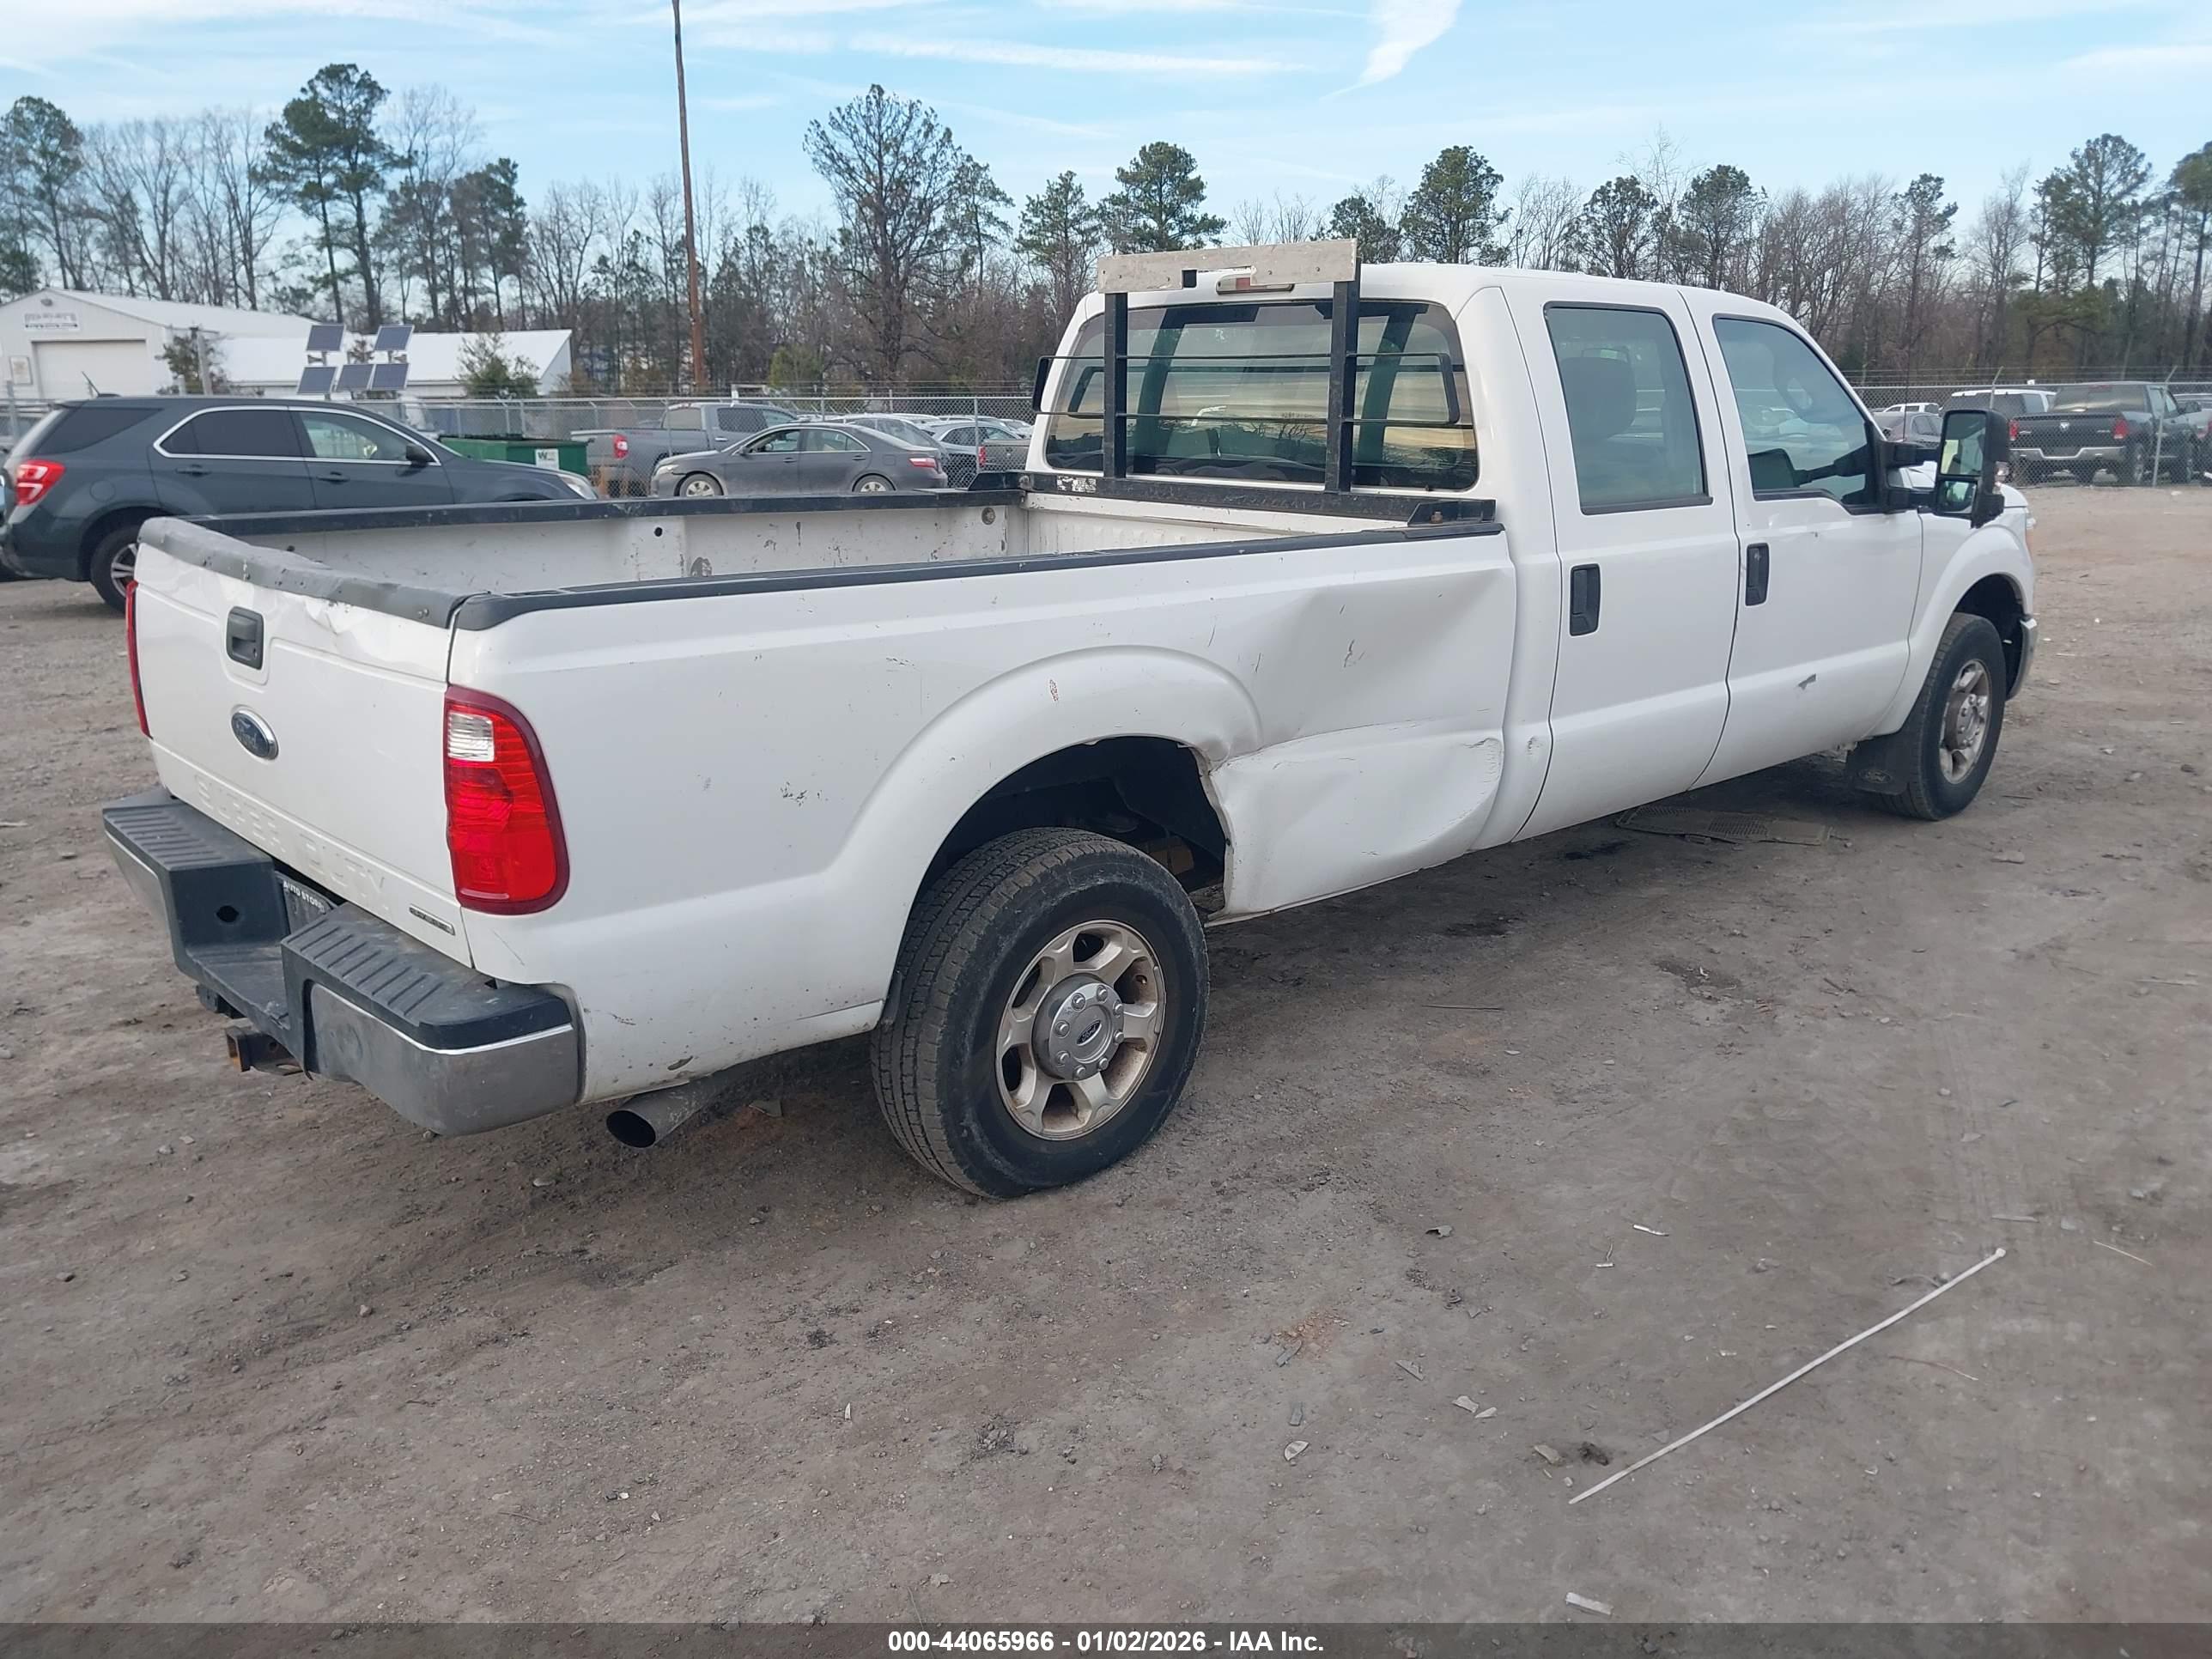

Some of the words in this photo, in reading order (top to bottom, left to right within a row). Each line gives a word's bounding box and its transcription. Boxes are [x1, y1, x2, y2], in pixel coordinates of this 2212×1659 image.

[195, 774, 287, 854] SUPER
[299, 833, 391, 910] DUTY
[283, 880, 301, 896] AUTO
